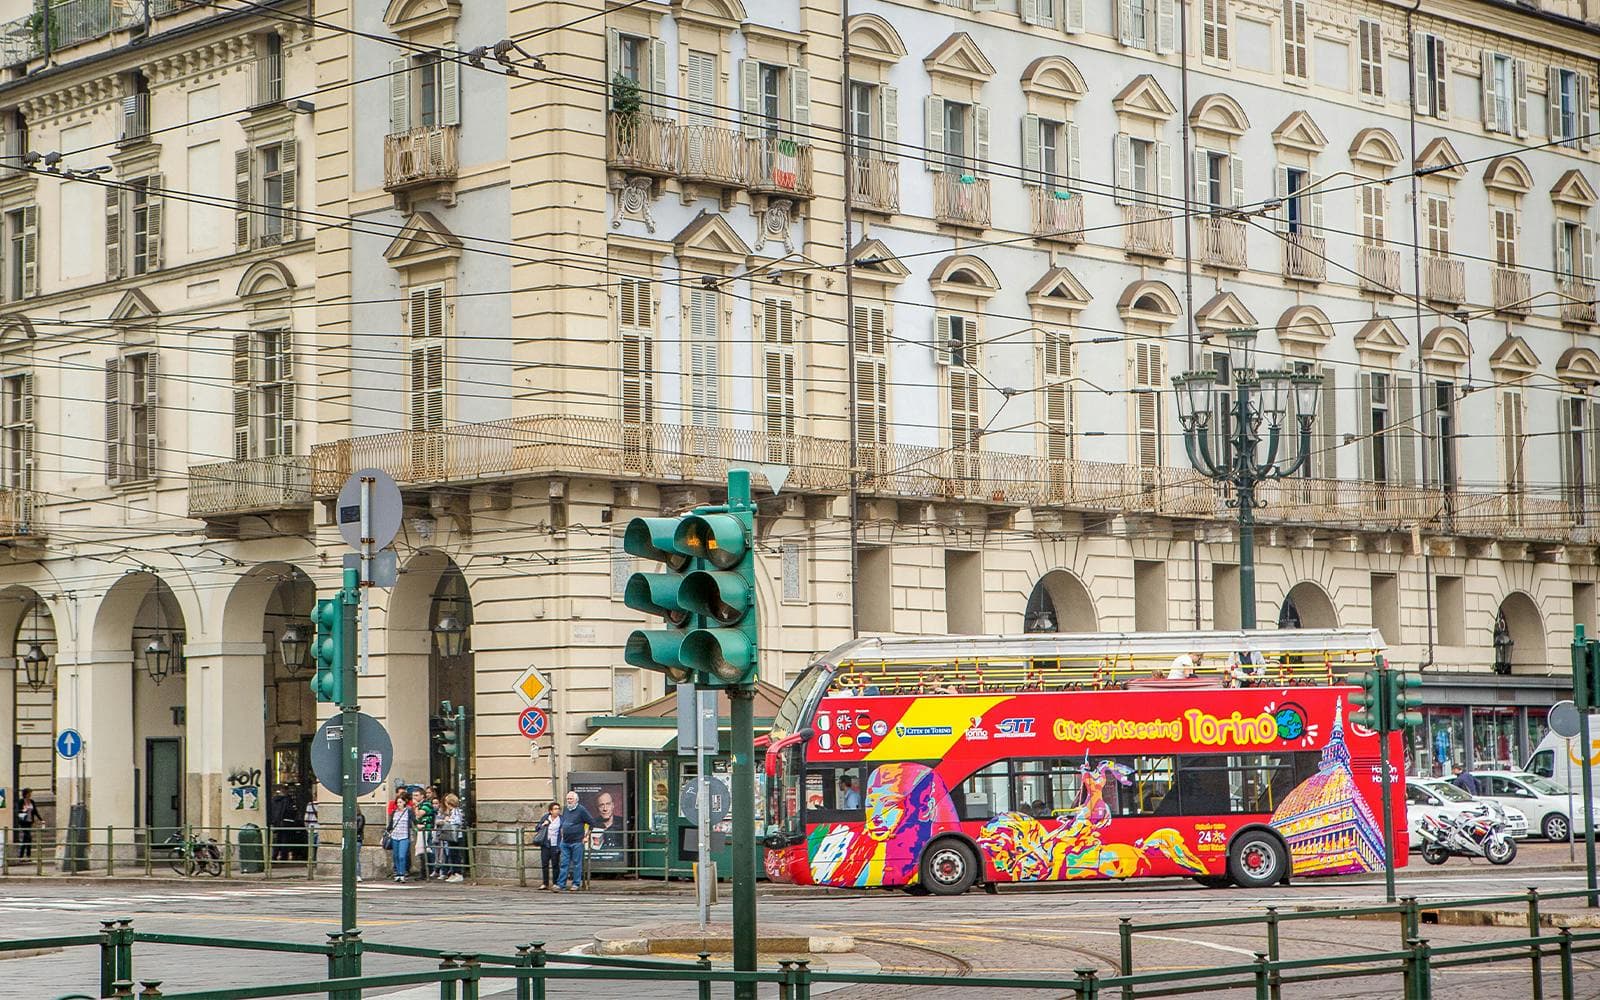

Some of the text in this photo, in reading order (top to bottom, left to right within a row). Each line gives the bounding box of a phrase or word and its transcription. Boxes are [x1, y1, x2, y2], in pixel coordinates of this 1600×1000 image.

[1001, 718, 1036, 734] GTT
[1184, 708, 1278, 745] Torino
[1198, 830, 1212, 844] 24
